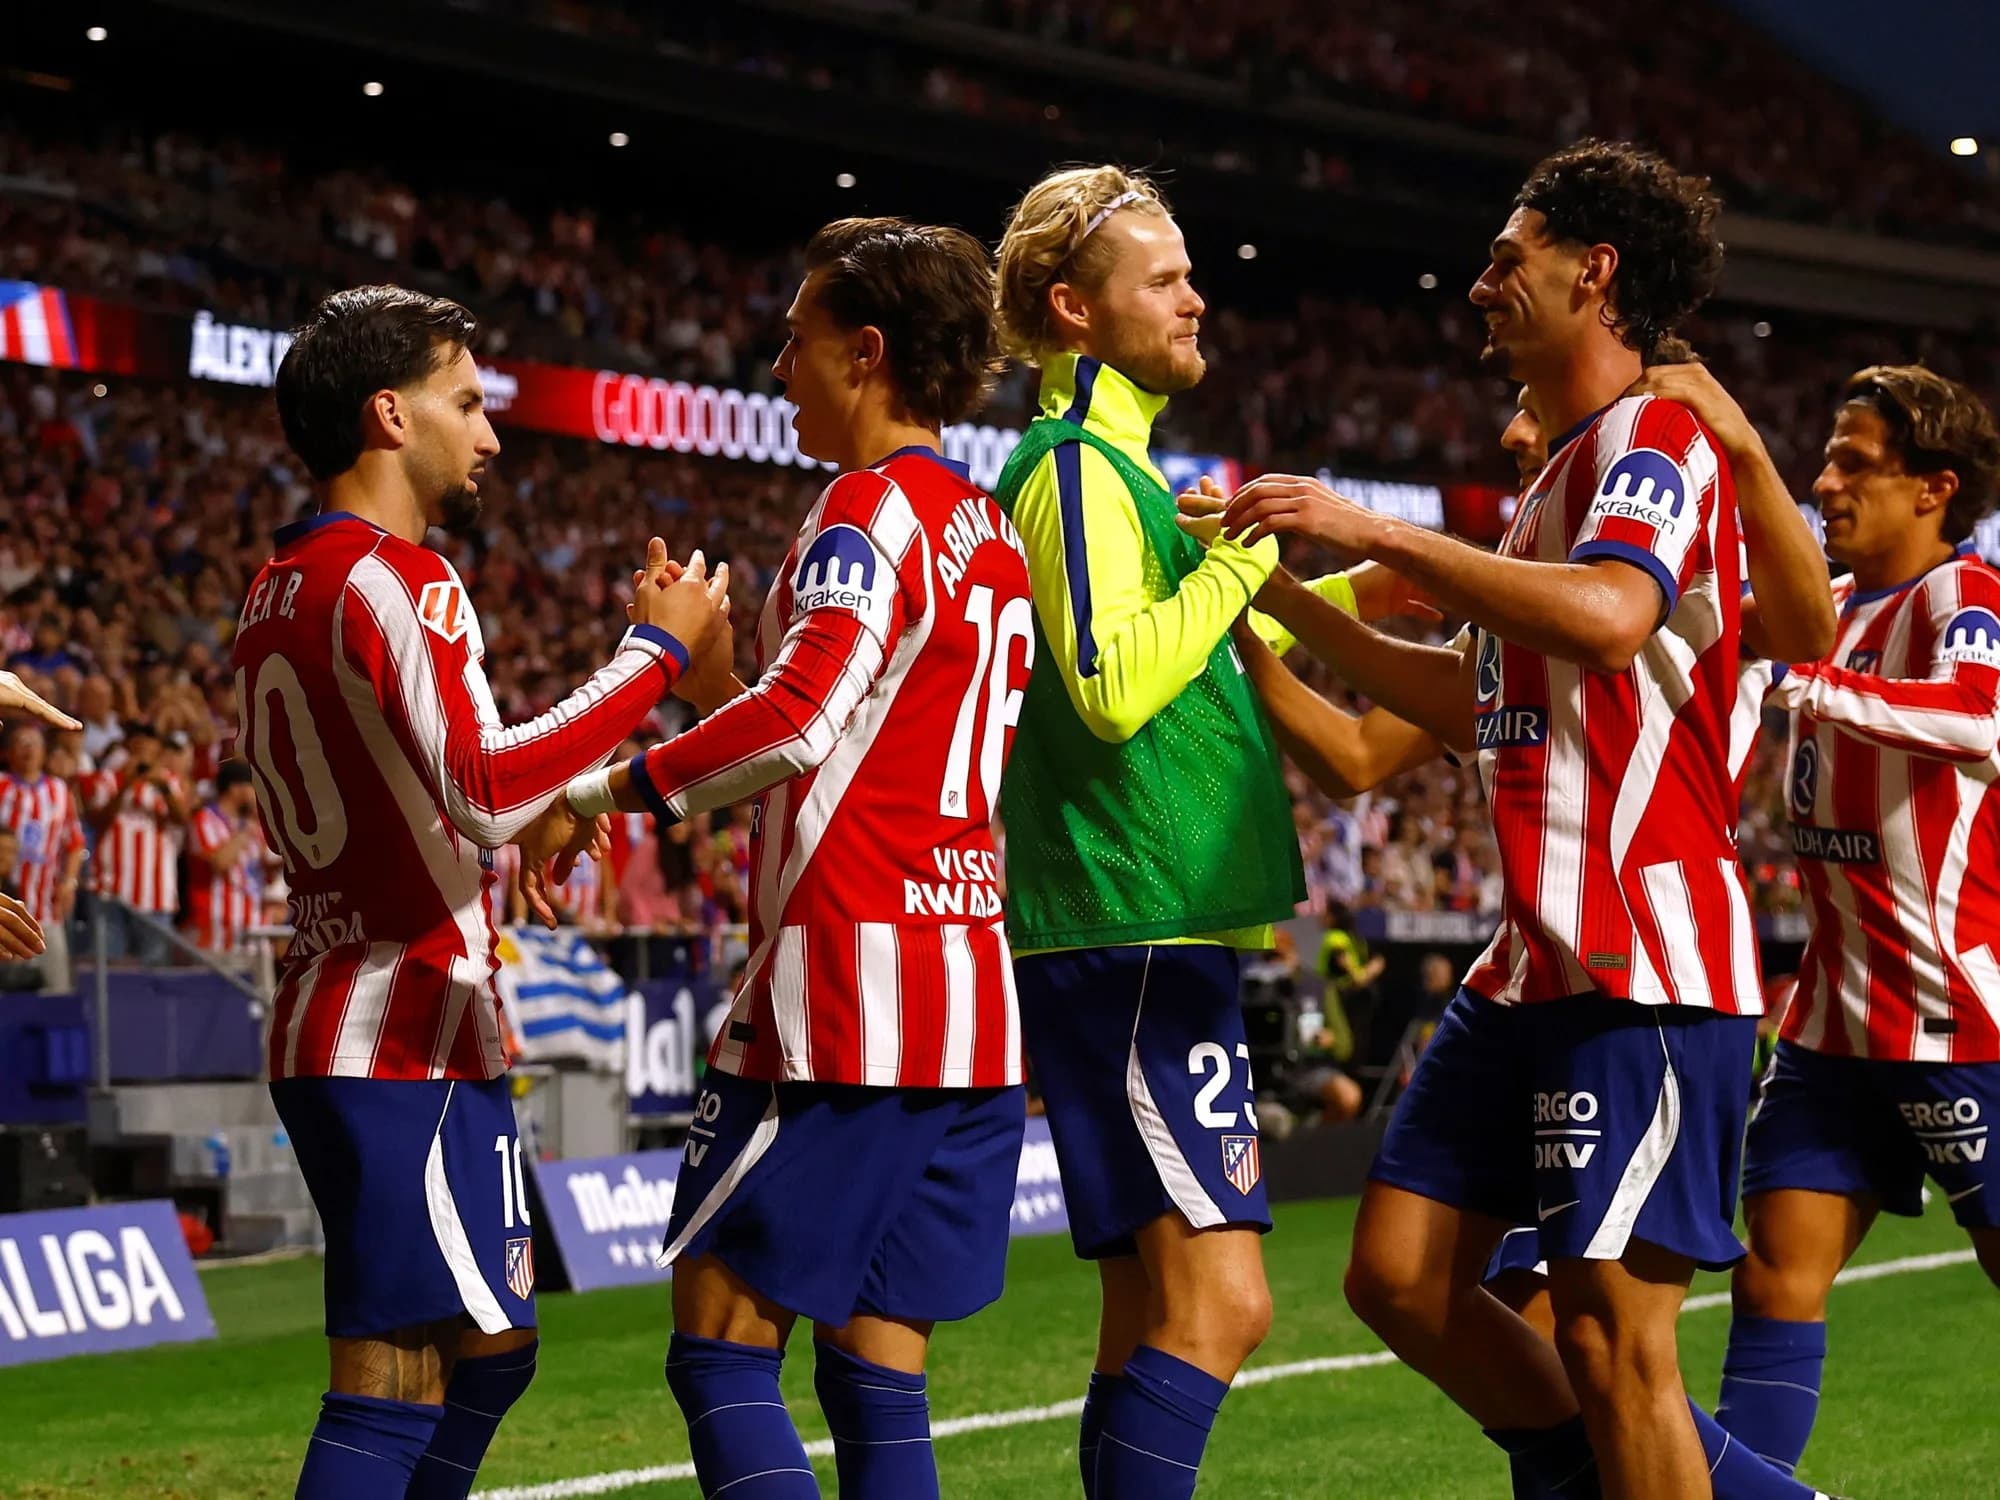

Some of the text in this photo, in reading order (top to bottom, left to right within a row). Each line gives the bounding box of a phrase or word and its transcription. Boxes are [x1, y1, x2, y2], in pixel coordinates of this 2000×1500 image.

[1593, 500, 1676, 535] kraken
[794, 589, 872, 615] kraken
[1826, 833, 1876, 861] AIR
[1898, 1096, 1981, 1128] ERGO
